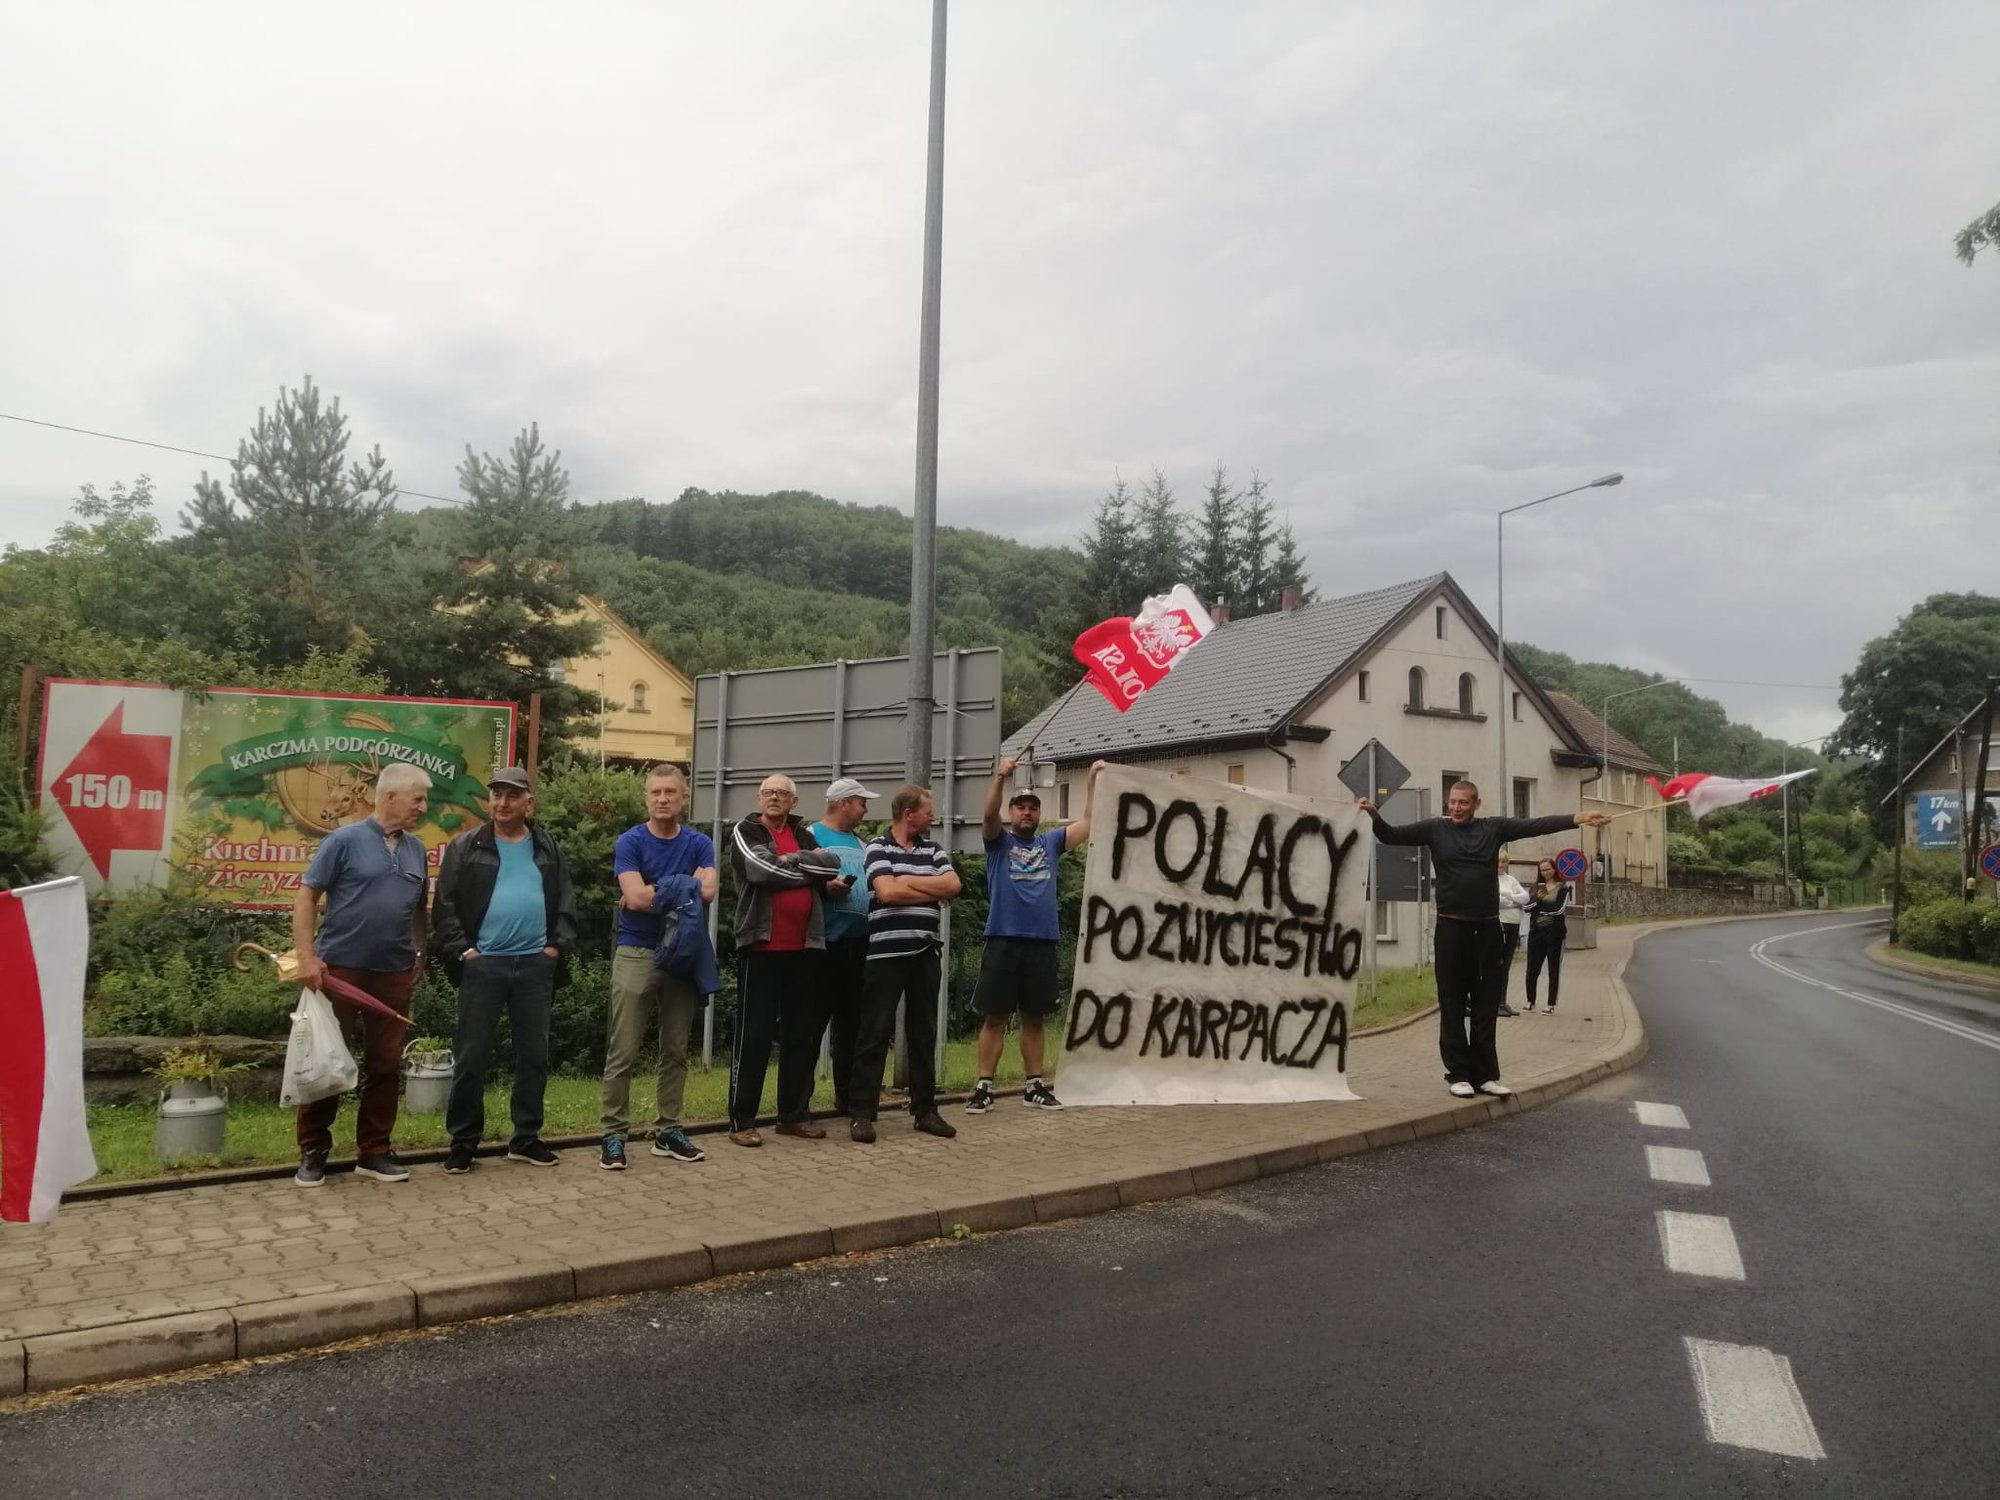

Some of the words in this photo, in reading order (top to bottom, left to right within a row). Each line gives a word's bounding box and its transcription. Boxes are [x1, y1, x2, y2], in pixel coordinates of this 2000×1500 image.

[229, 737, 320, 771] KARCZMA
[324, 735, 457, 781] PODGÓRZANKA
[66, 774, 132, 810] 150
[138, 789, 163, 810] m
[1112, 792, 1359, 926] POLACY
[1066, 989, 1132, 1052] DO
[1139, 994, 1348, 1074] KARPACZA
